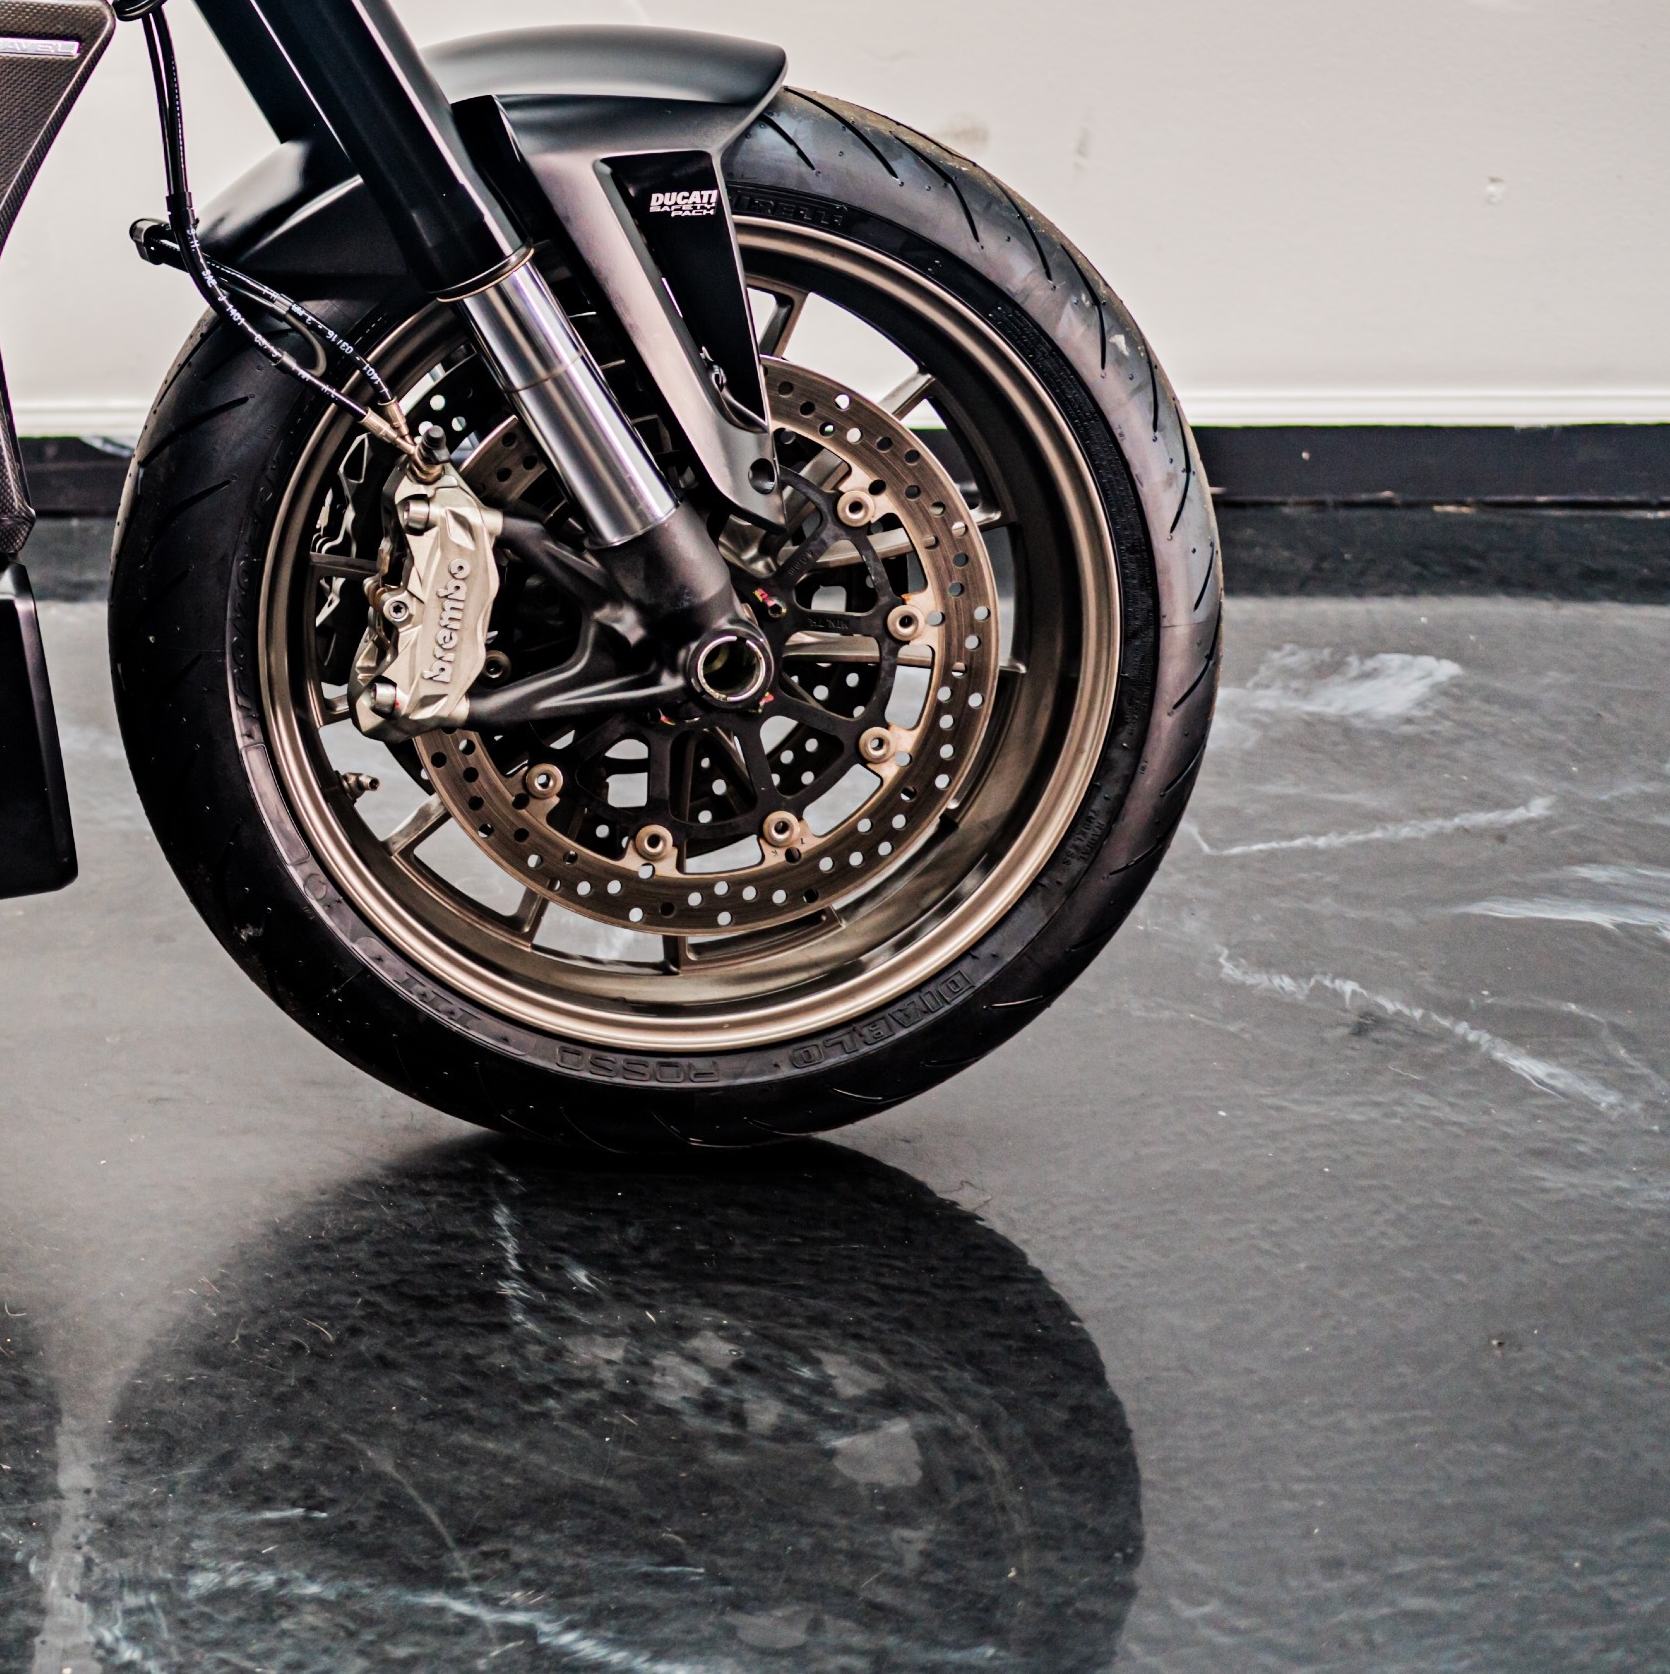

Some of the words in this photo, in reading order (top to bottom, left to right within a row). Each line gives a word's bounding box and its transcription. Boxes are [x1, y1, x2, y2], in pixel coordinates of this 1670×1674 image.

[649, 203, 716, 213] SAFETY
[650, 189, 718, 207] DUCATI
[422, 558, 471, 683] brembo
[788, 967, 976, 1070] DIABLO
[552, 1043, 720, 1083] ROSSO
